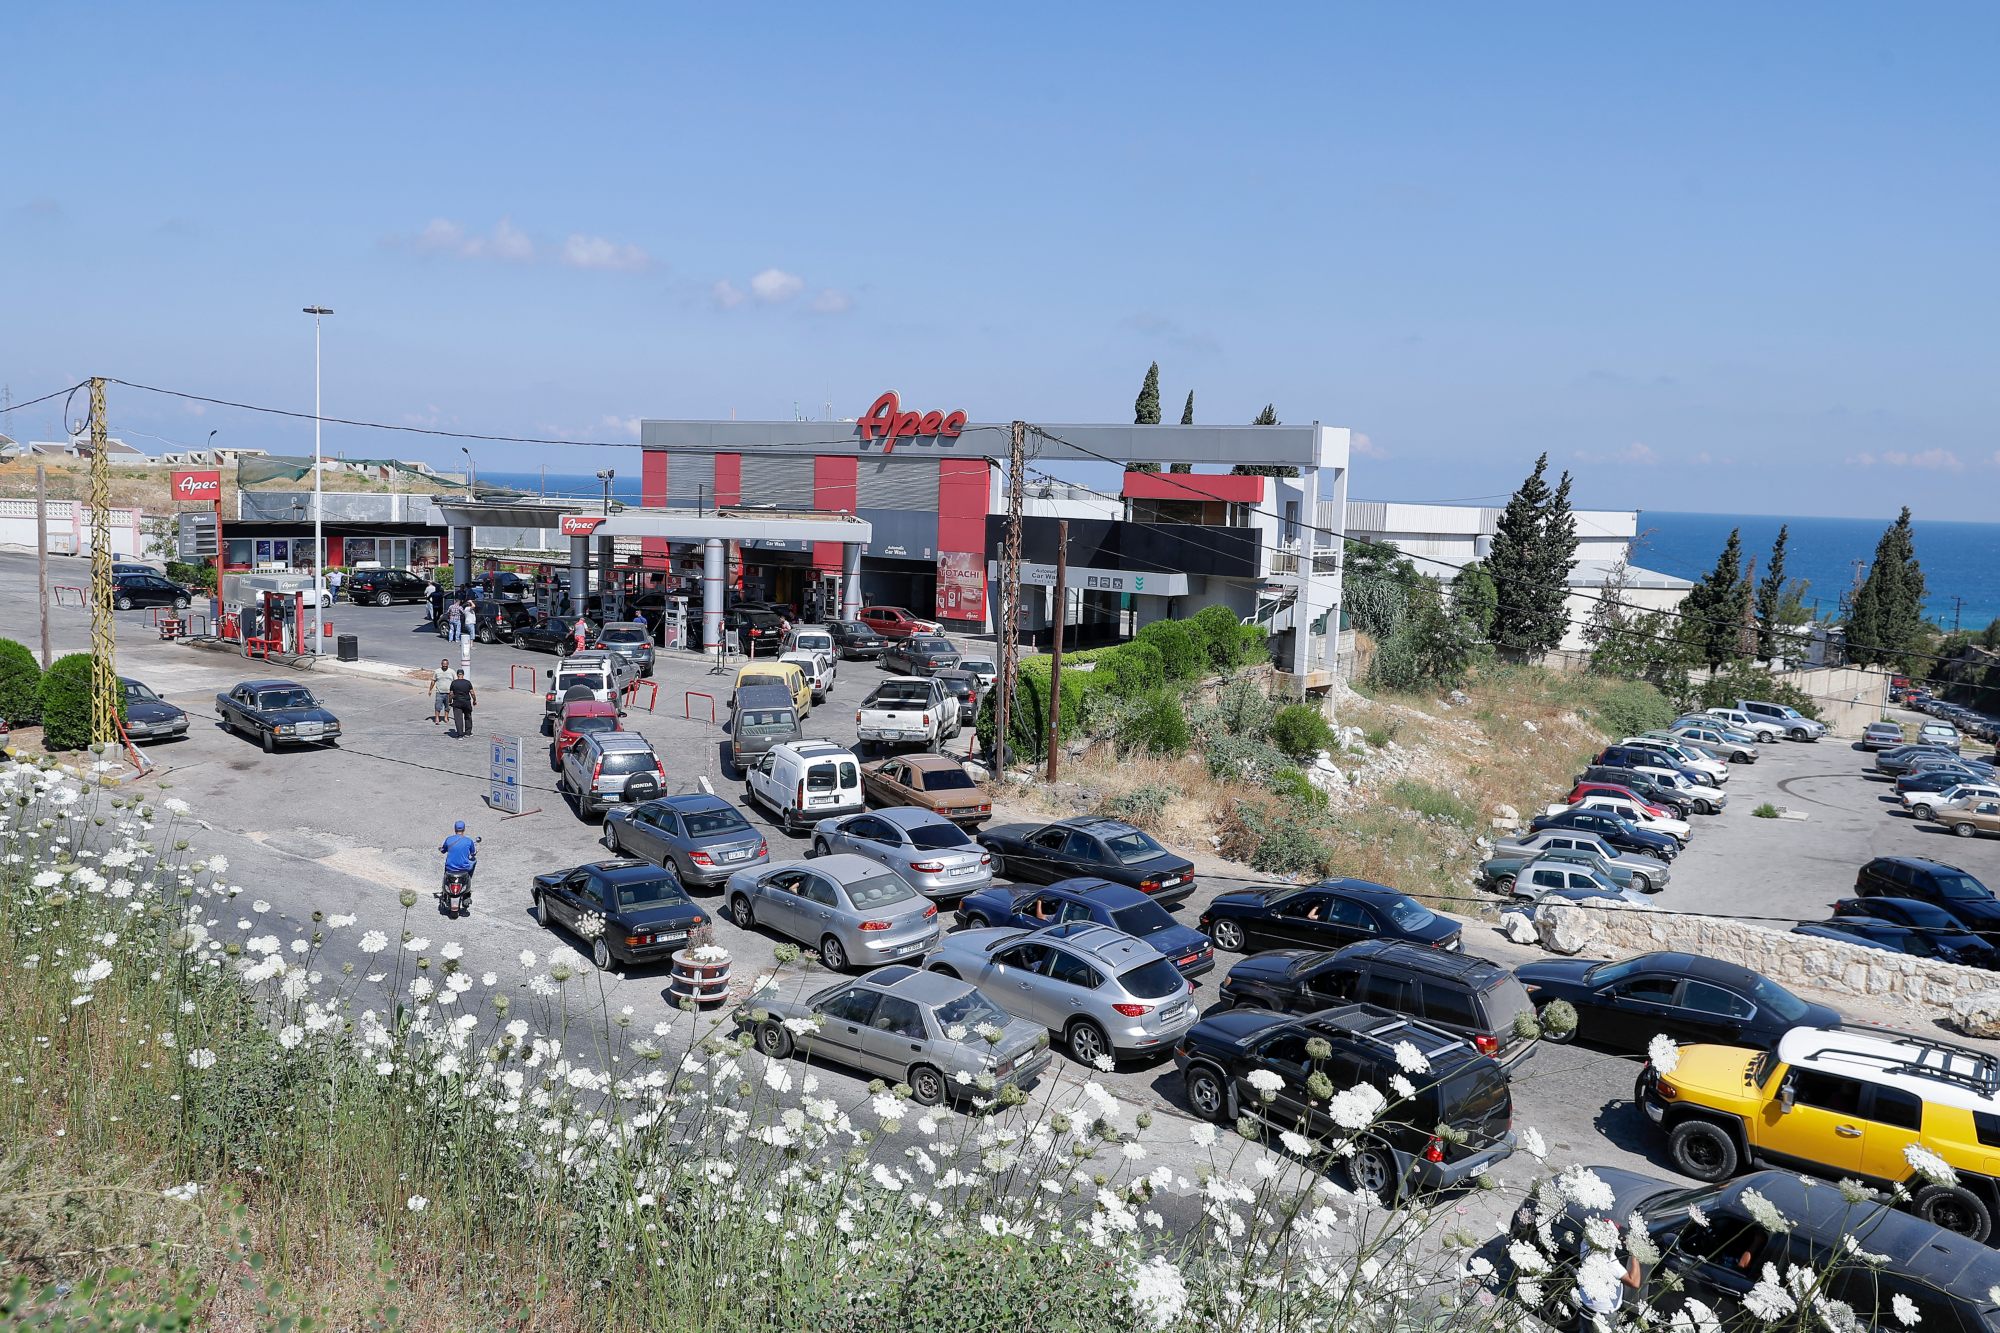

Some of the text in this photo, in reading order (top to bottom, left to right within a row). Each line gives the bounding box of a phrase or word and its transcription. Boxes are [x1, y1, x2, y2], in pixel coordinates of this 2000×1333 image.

[856, 390, 968, 453] Apec
[179, 476, 217, 496] Apec
[564, 518, 594, 532] Apec
[940, 570, 979, 579] TOTACHI
[281, 581, 299, 590] Apec
